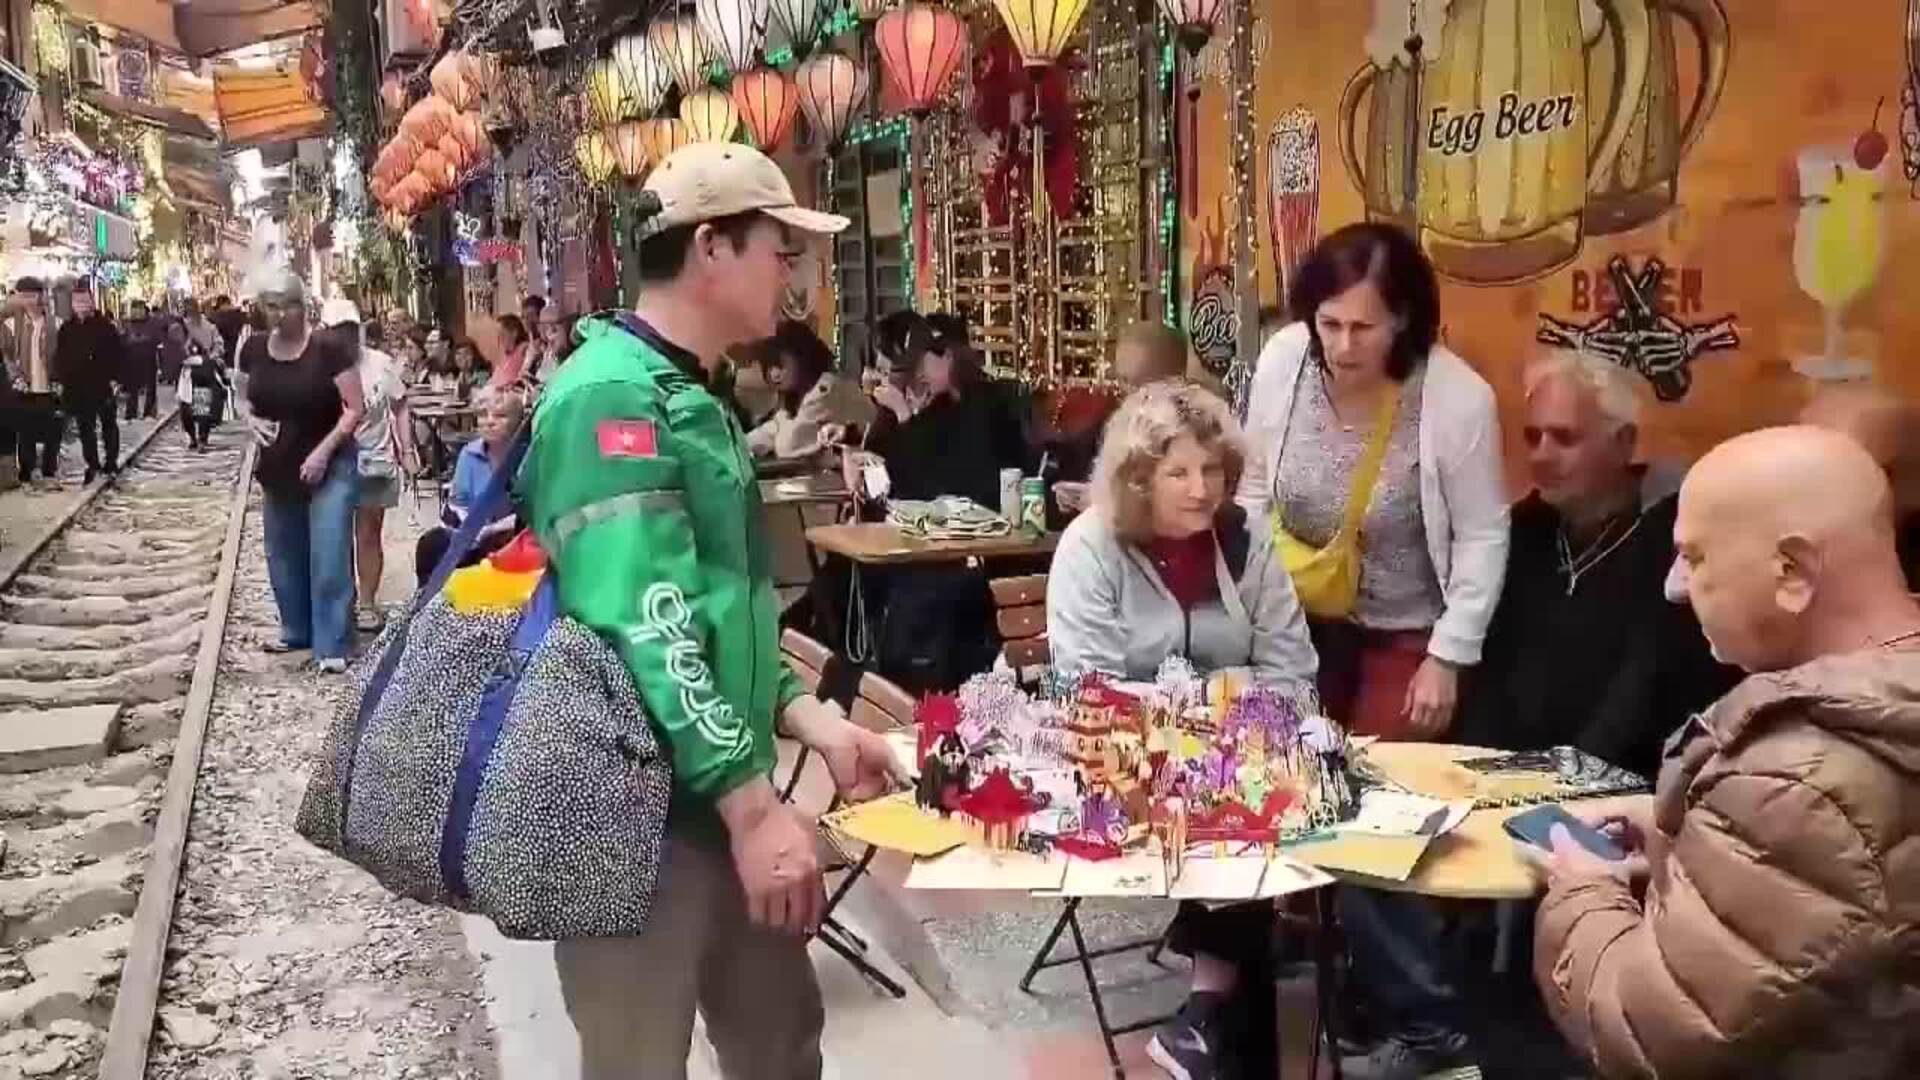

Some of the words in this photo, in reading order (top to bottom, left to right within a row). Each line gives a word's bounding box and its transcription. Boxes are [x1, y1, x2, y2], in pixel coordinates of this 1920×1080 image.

[1428, 107, 1486, 156] Egg
[1495, 92, 1575, 140] Beer
[1191, 295, 1240, 351] Bee
